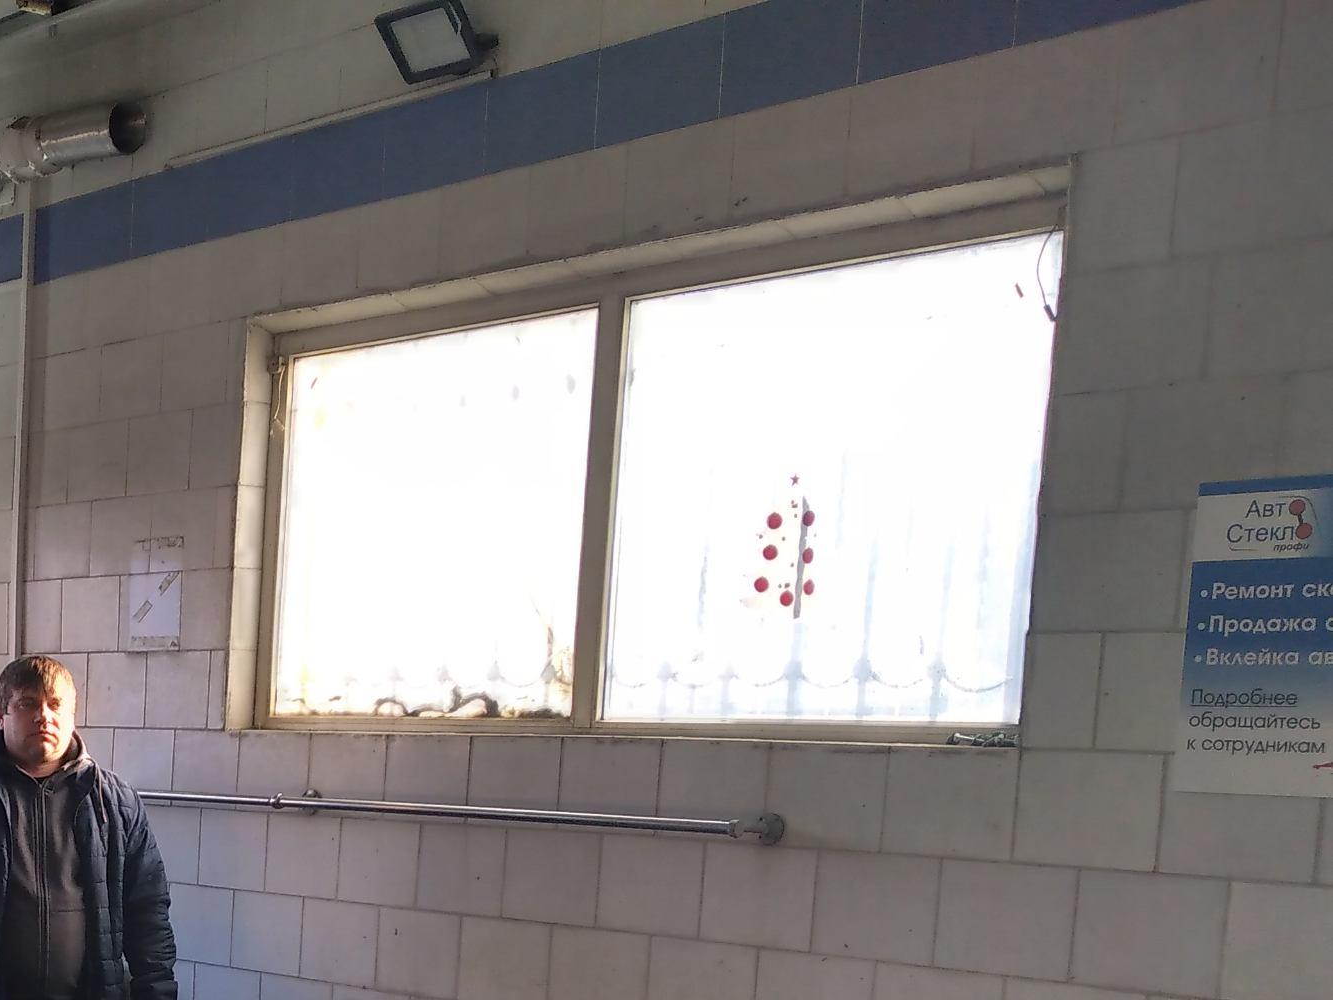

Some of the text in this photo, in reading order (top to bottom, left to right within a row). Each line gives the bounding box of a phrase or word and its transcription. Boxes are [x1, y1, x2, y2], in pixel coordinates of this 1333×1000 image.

[1273, 542, 1310, 553] профи
[1211, 582, 1333, 600] Ремонт ск
[1209, 614, 1317, 637] Продажа
[1206, 647, 1299, 666] Вклейка
[1191, 688, 1298, 708] Подробнее
[1188, 711, 1321, 732] обращайтесь
[1186, 738, 1326, 756] к сотрудникам
